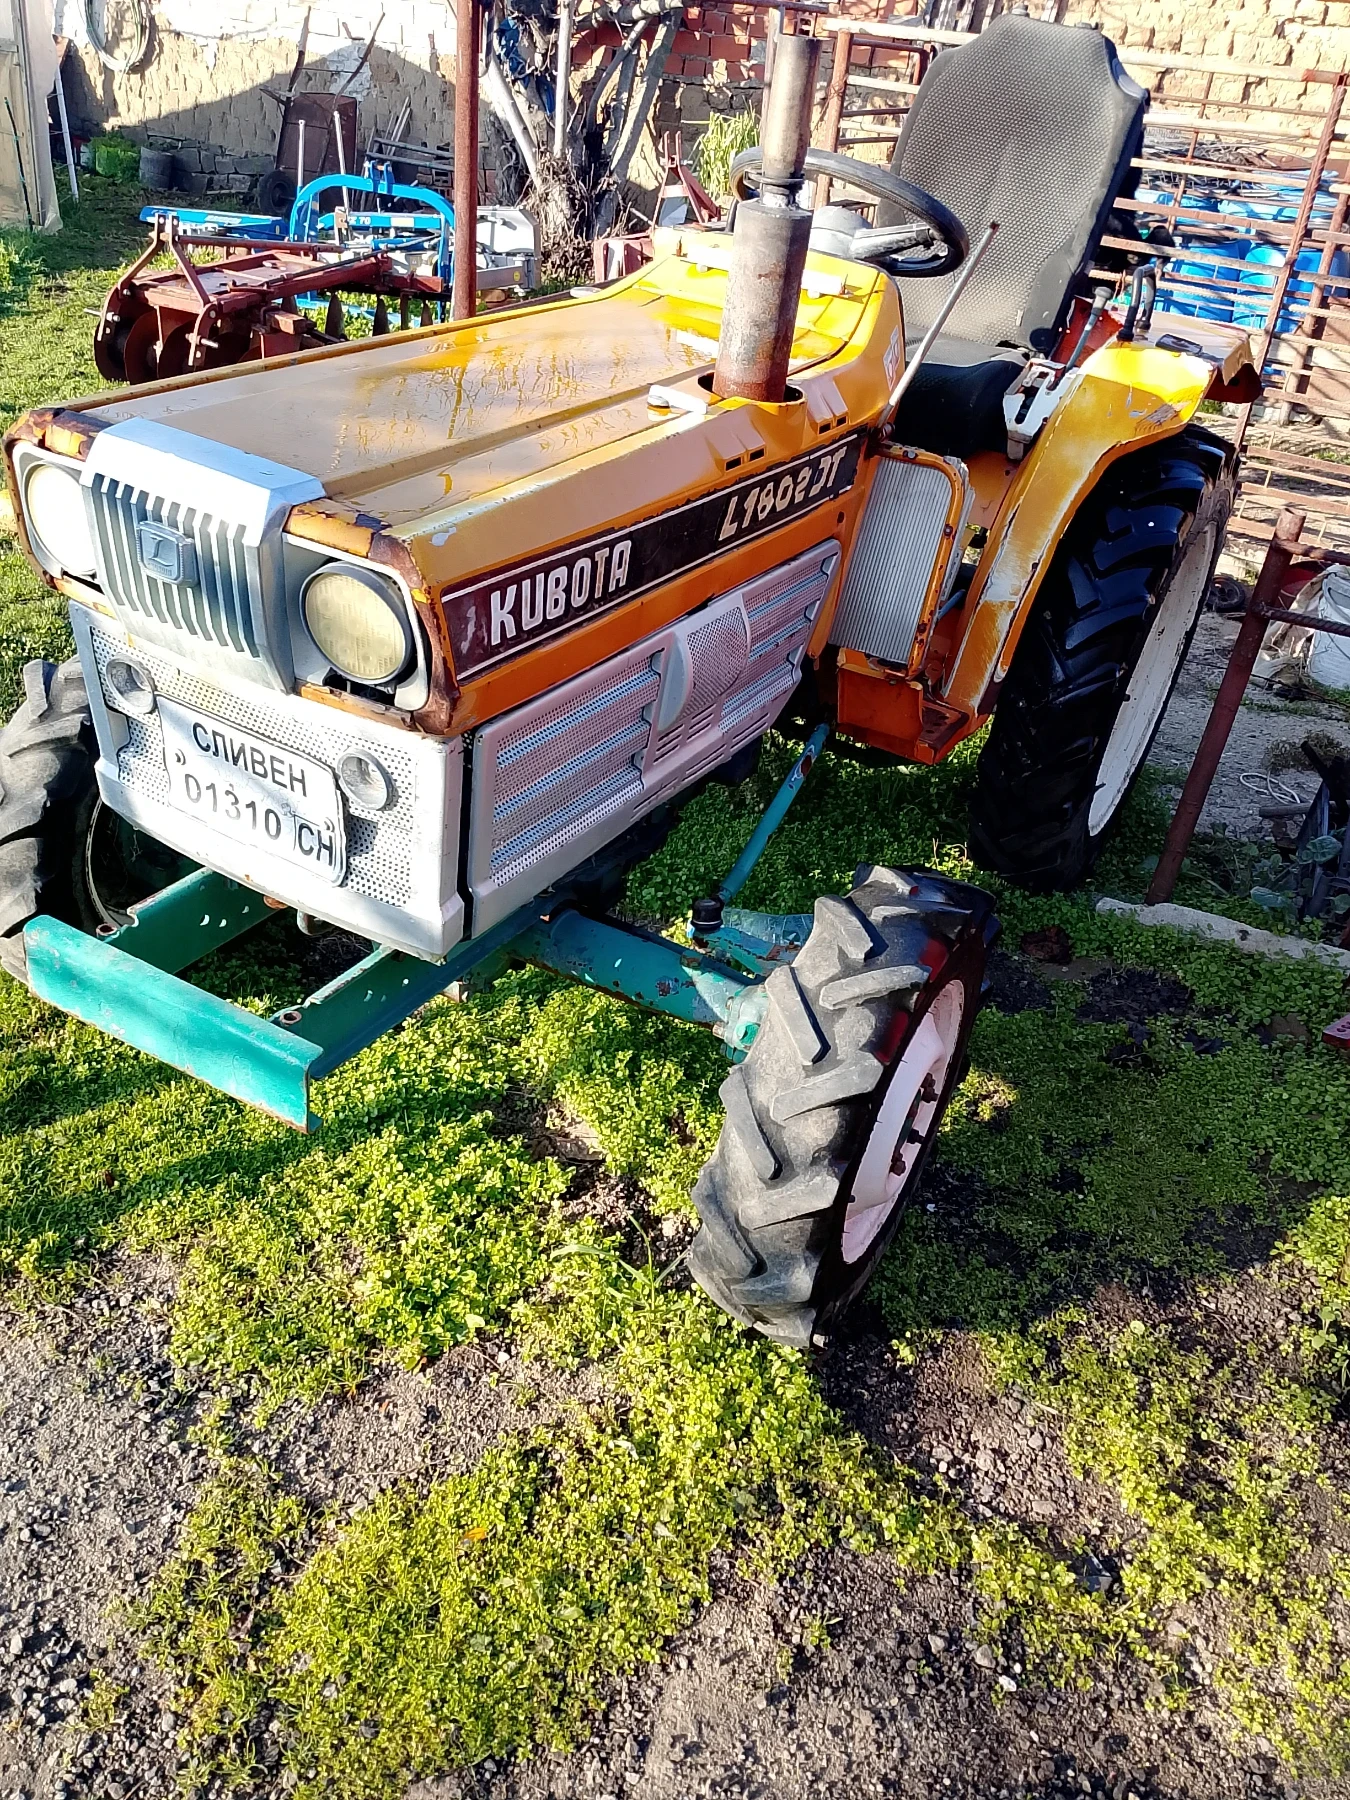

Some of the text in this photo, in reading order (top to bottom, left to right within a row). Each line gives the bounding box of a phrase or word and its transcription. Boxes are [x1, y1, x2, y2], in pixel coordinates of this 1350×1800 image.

[359, 216, 372, 226] 70
[490, 540, 632, 646] KUBOTA
[192, 722, 307, 797] СЛИВЕН
[184, 773, 282, 840] 01310
